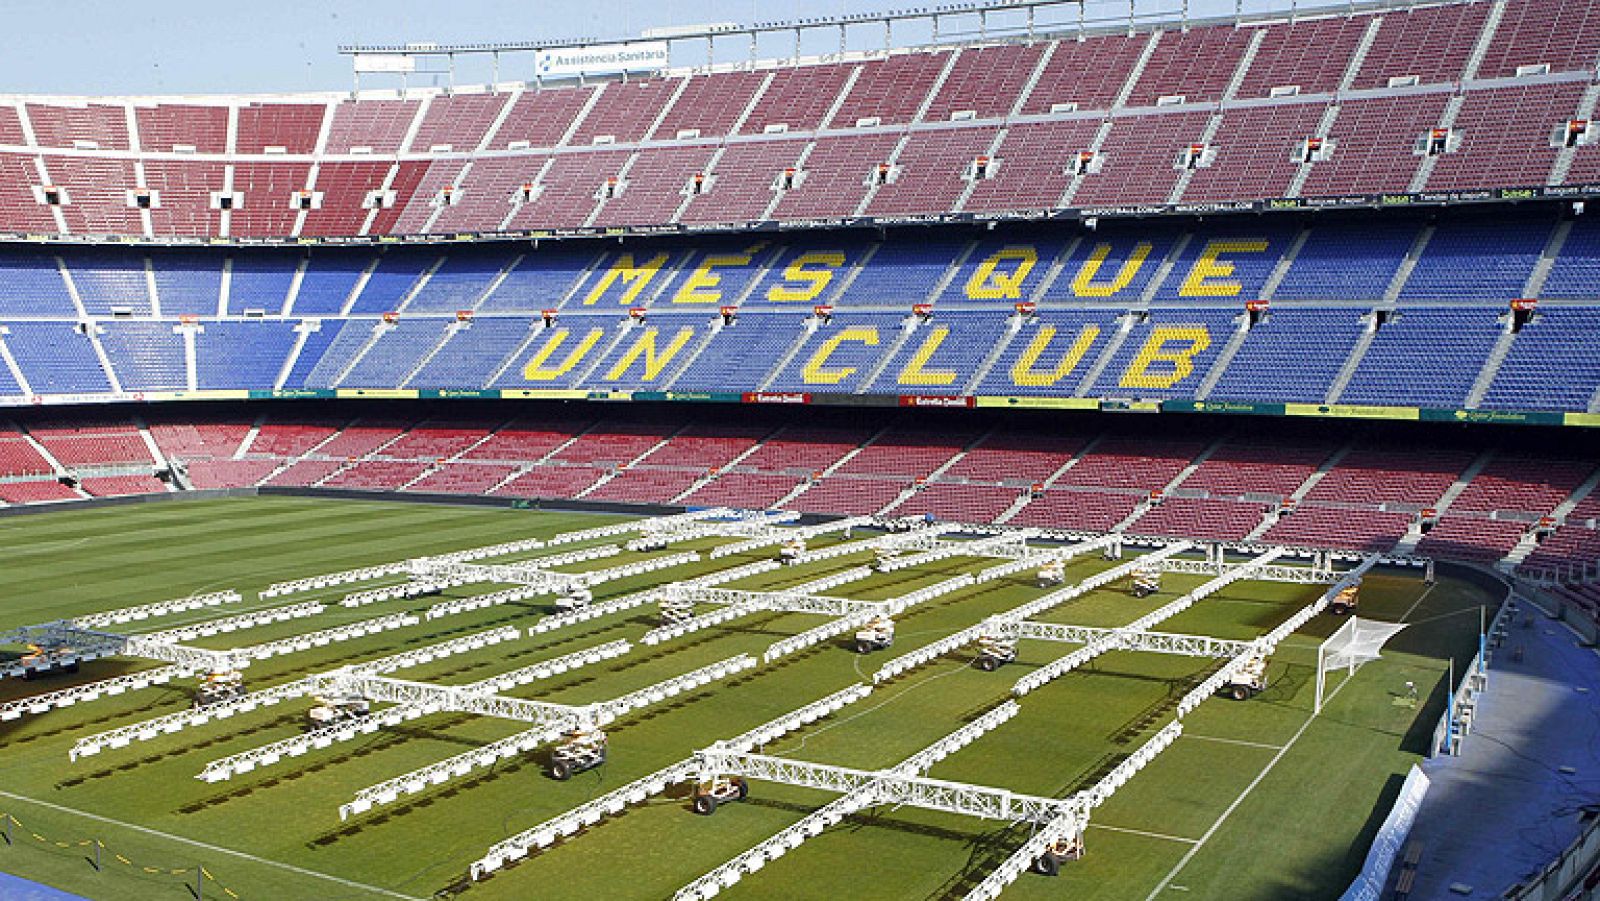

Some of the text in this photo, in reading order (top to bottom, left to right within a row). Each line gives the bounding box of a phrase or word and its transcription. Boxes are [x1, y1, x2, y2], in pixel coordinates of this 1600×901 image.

[583, 239, 1269, 305] MÉS QUE
[524, 323, 1212, 389] UN CLUB
